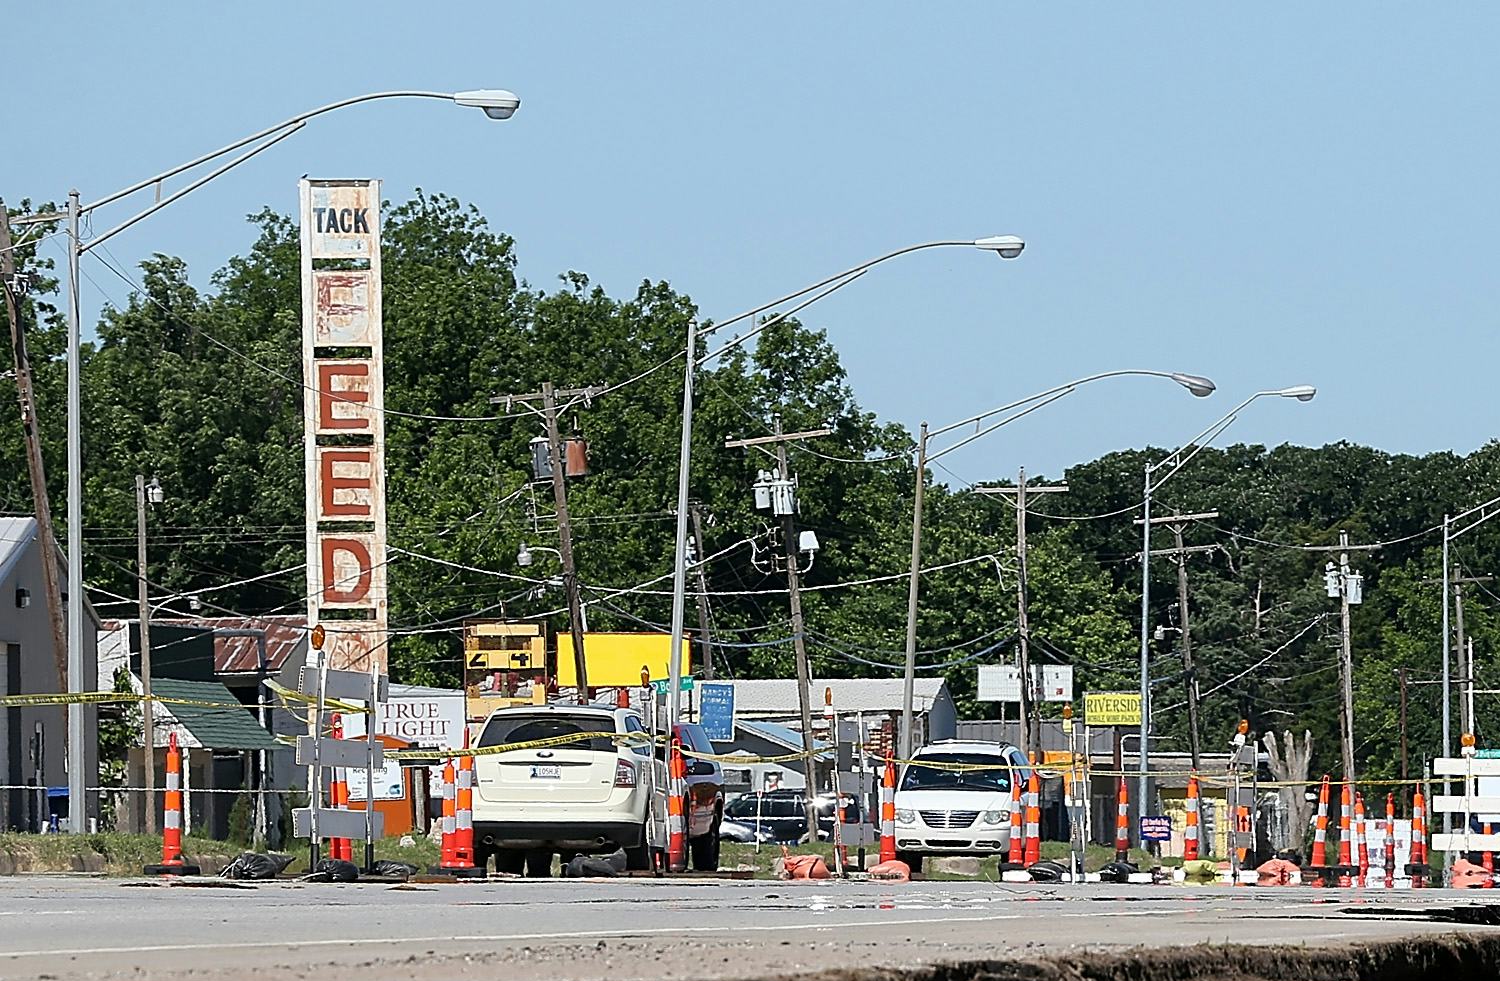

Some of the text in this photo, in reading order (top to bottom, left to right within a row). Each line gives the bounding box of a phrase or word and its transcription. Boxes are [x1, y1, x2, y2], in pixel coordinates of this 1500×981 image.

[313, 207, 370, 234] TACK
[380, 703, 440, 719] TRUE
[381, 720, 451, 736] LIGHT
